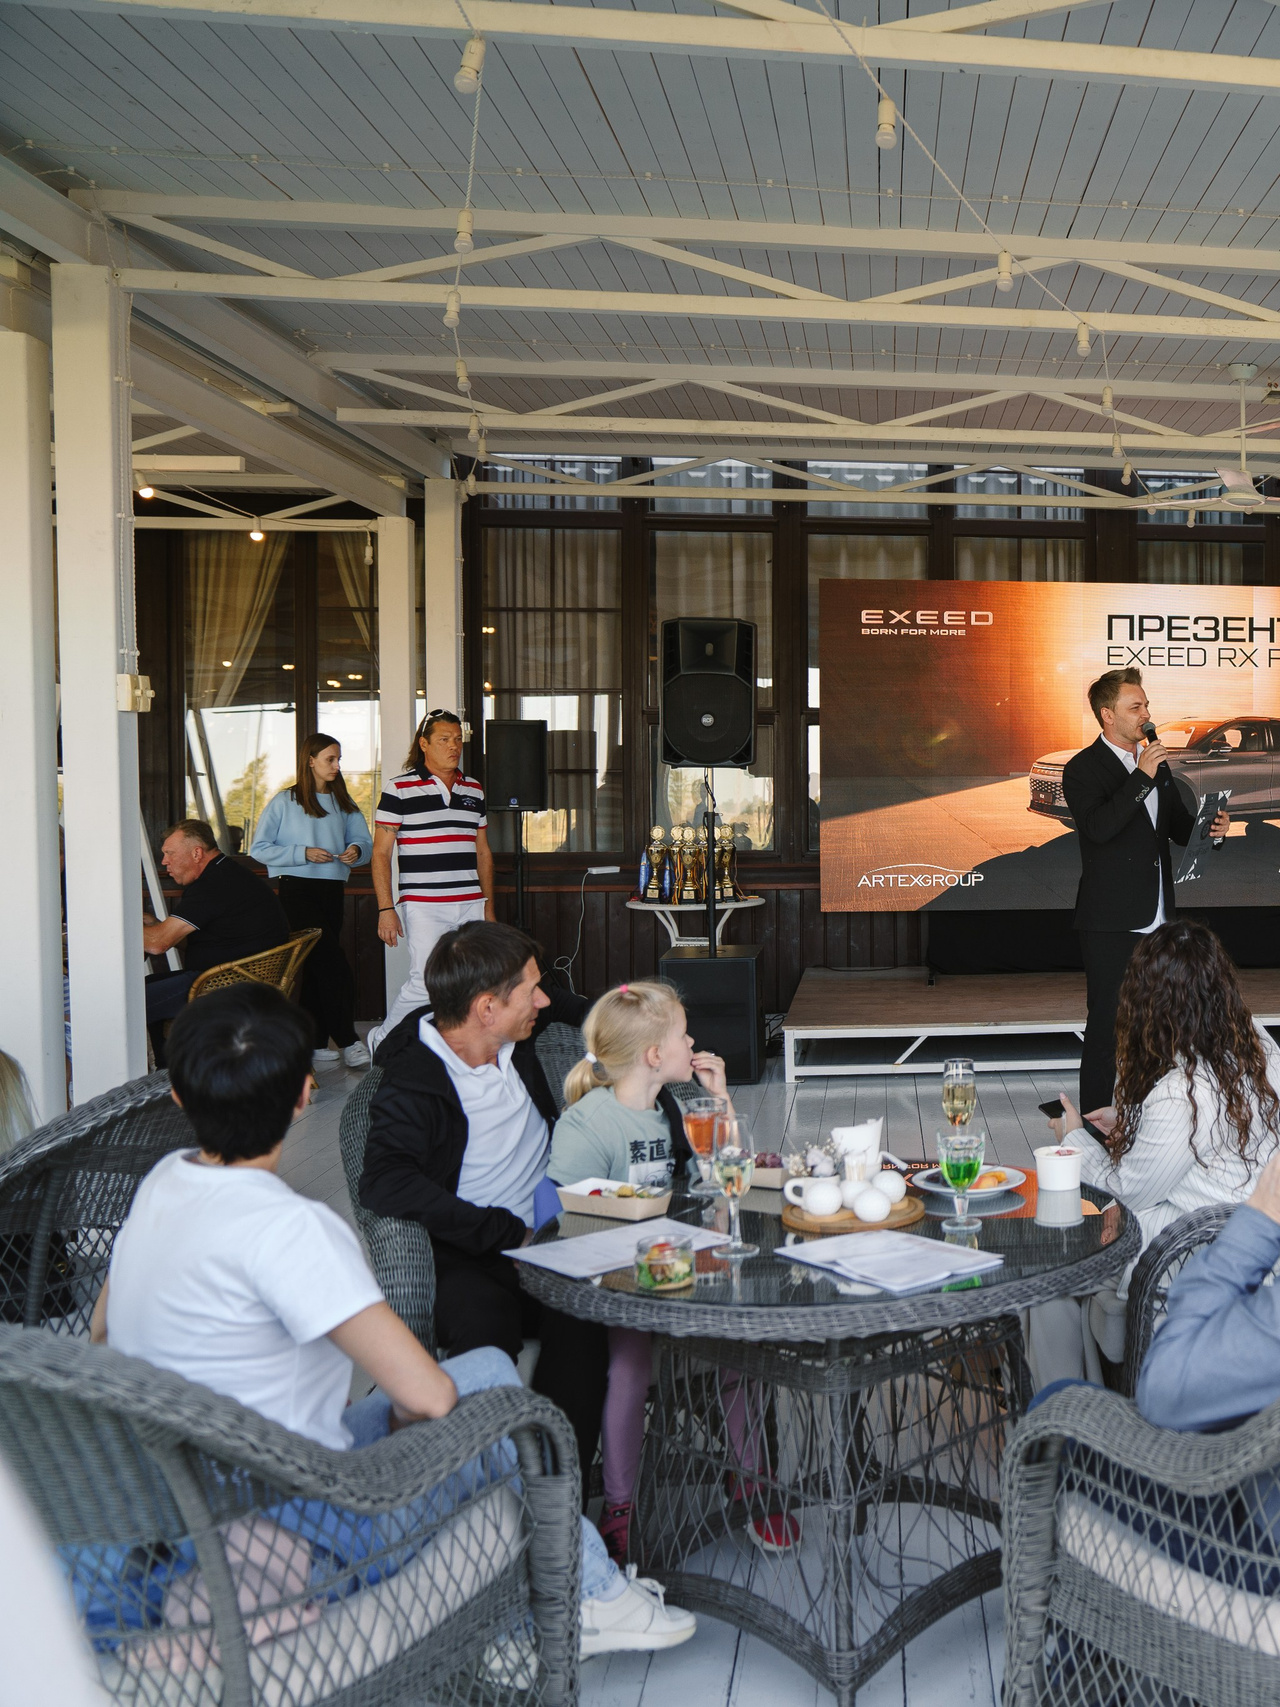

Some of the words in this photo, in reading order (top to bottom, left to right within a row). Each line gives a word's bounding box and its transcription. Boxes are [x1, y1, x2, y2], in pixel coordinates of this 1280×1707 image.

[861, 610, 993, 625] EXEED
[901, 628, 927, 636] FOR
[1107, 646, 1207, 667] EXEED
[1218, 648, 1259, 668] RX
